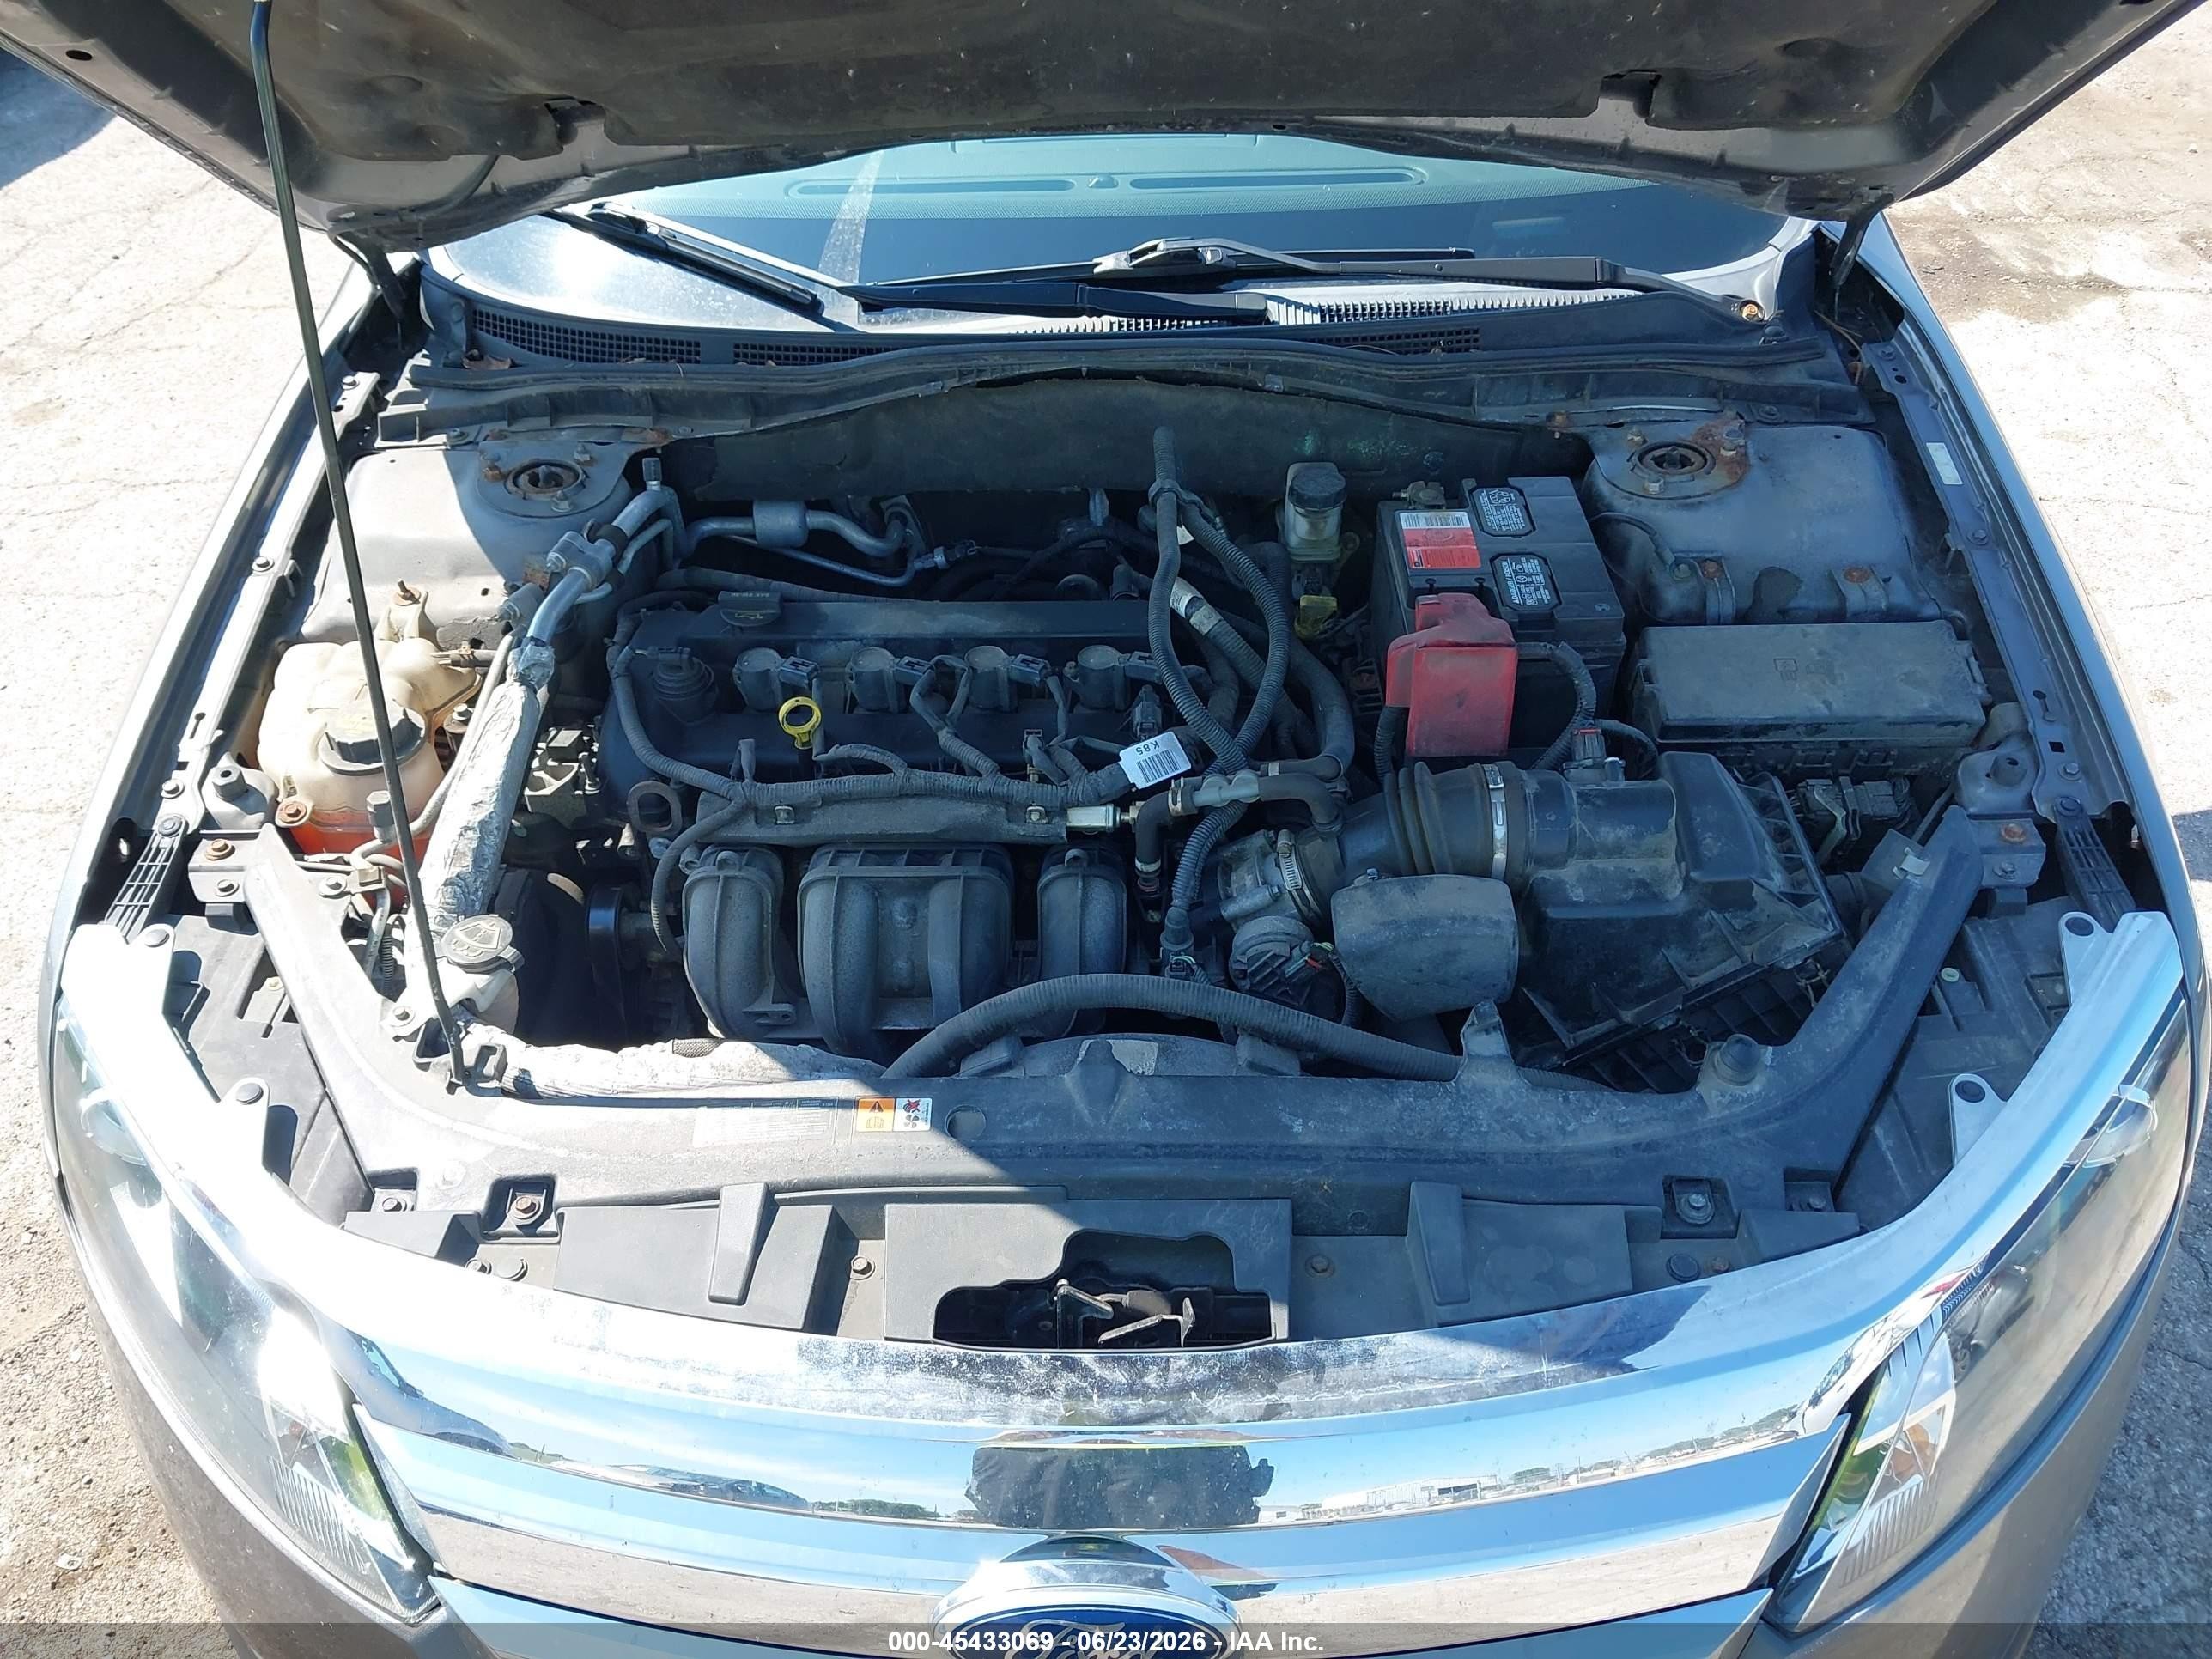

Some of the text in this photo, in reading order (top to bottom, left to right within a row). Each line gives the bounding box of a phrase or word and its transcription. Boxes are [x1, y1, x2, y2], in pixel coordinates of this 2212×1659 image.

[1501, 561, 1512, 578] POISON
[1507, 580, 1519, 599] DANGER
[1135, 739, 1160, 756] K85
